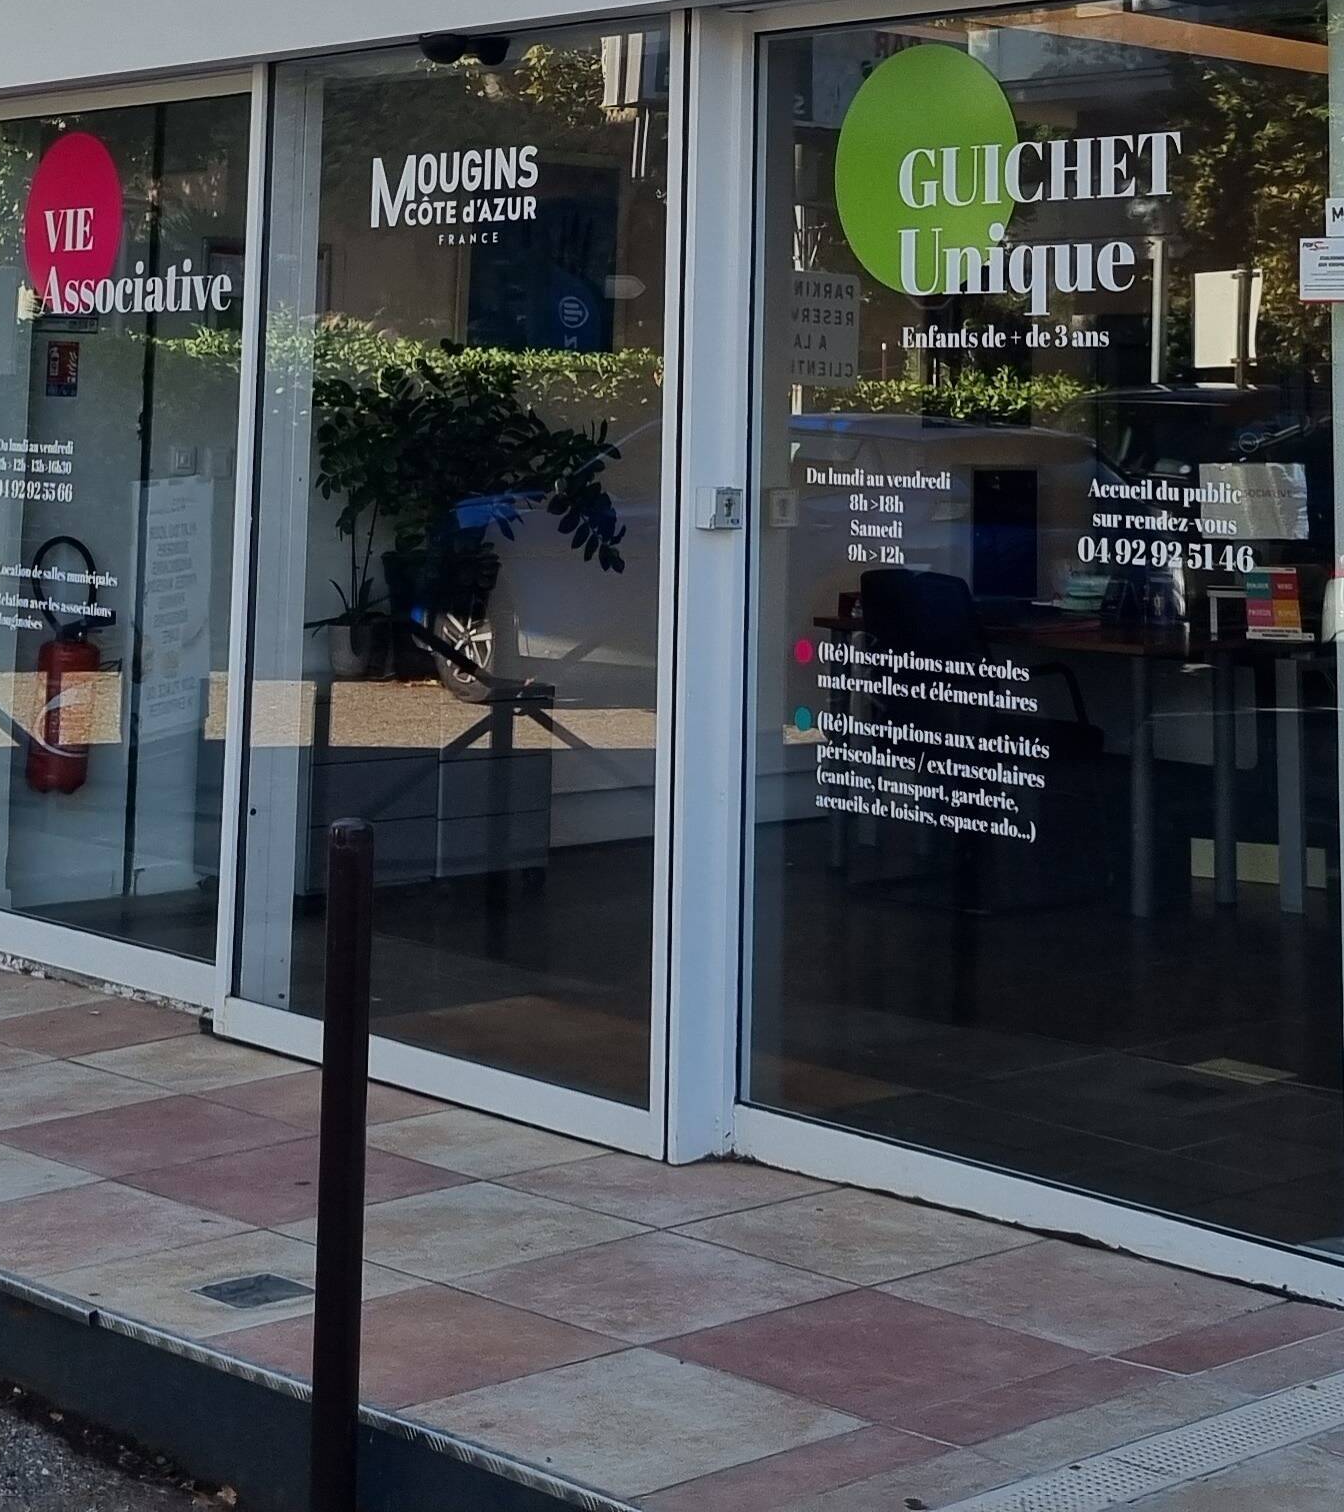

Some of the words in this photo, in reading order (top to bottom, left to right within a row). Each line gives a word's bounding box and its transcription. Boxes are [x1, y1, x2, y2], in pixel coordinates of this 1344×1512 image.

[897, 130, 1184, 209] GUICHET
[370, 145, 539, 229] MOUGINS
[404, 196, 457, 226] CÔTE
[44, 207, 96, 253] VIE
[438, 231, 500, 247] FRANCE
[898, 222, 1136, 316] Unique
[40, 258, 233, 316] Associative
[901, 324, 979, 349] Enfants
[981, 324, 1006, 349] de
[1025, 324, 1051, 349] de
[1055, 324, 1068, 348] 3
[1071, 330, 1110, 349] ans
[806, 467, 826, 485] Du
[828, 467, 864, 487] lundi
[866, 474, 884, 488] au
[887, 470, 951, 490] vendredi
[1088, 478, 1152, 500] Accueil
[1156, 480, 1179, 501] du
[1183, 482, 1242, 507] public
[849, 493, 868, 512] 8h
[850, 519, 903, 539] Samedi
[1092, 512, 1122, 528] sur
[1125, 510, 1237, 534] rendez-vous
[1078, 536, 1111, 564] 04
[1115, 538, 1147, 565] 92
[1151, 540, 1183, 568] 92
[1187, 543, 1214, 571] 51
[1218, 545, 1254, 573] 46
[945, 661, 975, 677] aux
[979, 658, 1030, 682] écoles
[817, 673, 908, 697] maternelles
[911, 683, 926, 700] et
[929, 682, 1038, 712] élémentaires
[945, 731, 975, 750] aux
[978, 734, 1050, 759] activités
[817, 740, 916, 771] périscolaires
[927, 758, 1045, 788] extrascolaires
[816, 765, 876, 792] (cantine,
[878, 775, 949, 803] transport,
[951, 788, 1019, 814] garderie,
[816, 793, 870, 815] accueils
[871, 798, 889, 817] de
[890, 800, 937, 827] loisirs,
[939, 814, 988, 834] espace
